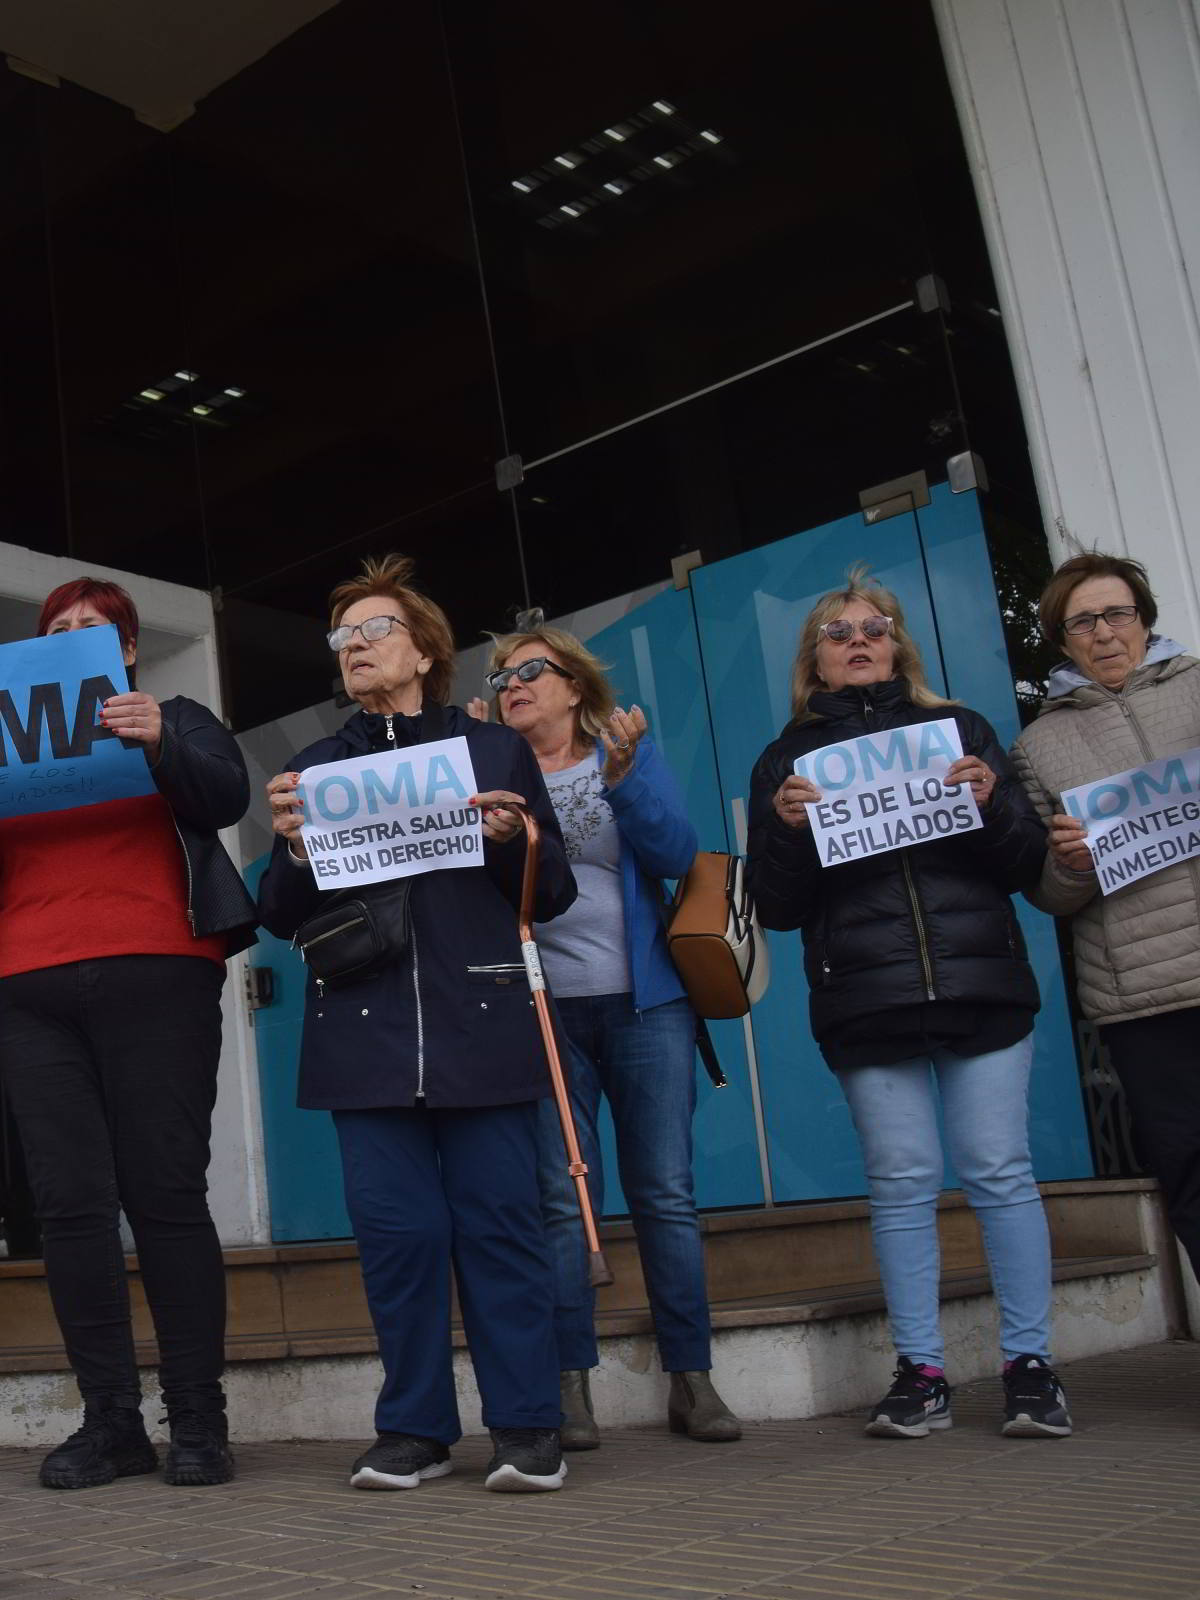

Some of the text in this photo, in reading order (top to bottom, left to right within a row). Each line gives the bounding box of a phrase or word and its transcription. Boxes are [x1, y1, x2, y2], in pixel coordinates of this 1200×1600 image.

[29, 767, 77, 780] LOS
[1066, 758, 1200, 831] IOM
[410, 807, 479, 835] SALUD
[815, 799, 851, 829] ES
[857, 786, 899, 819] DE
[315, 833, 479, 878] ES UN DERECHO!
[827, 804, 974, 863] AFILIADOS
